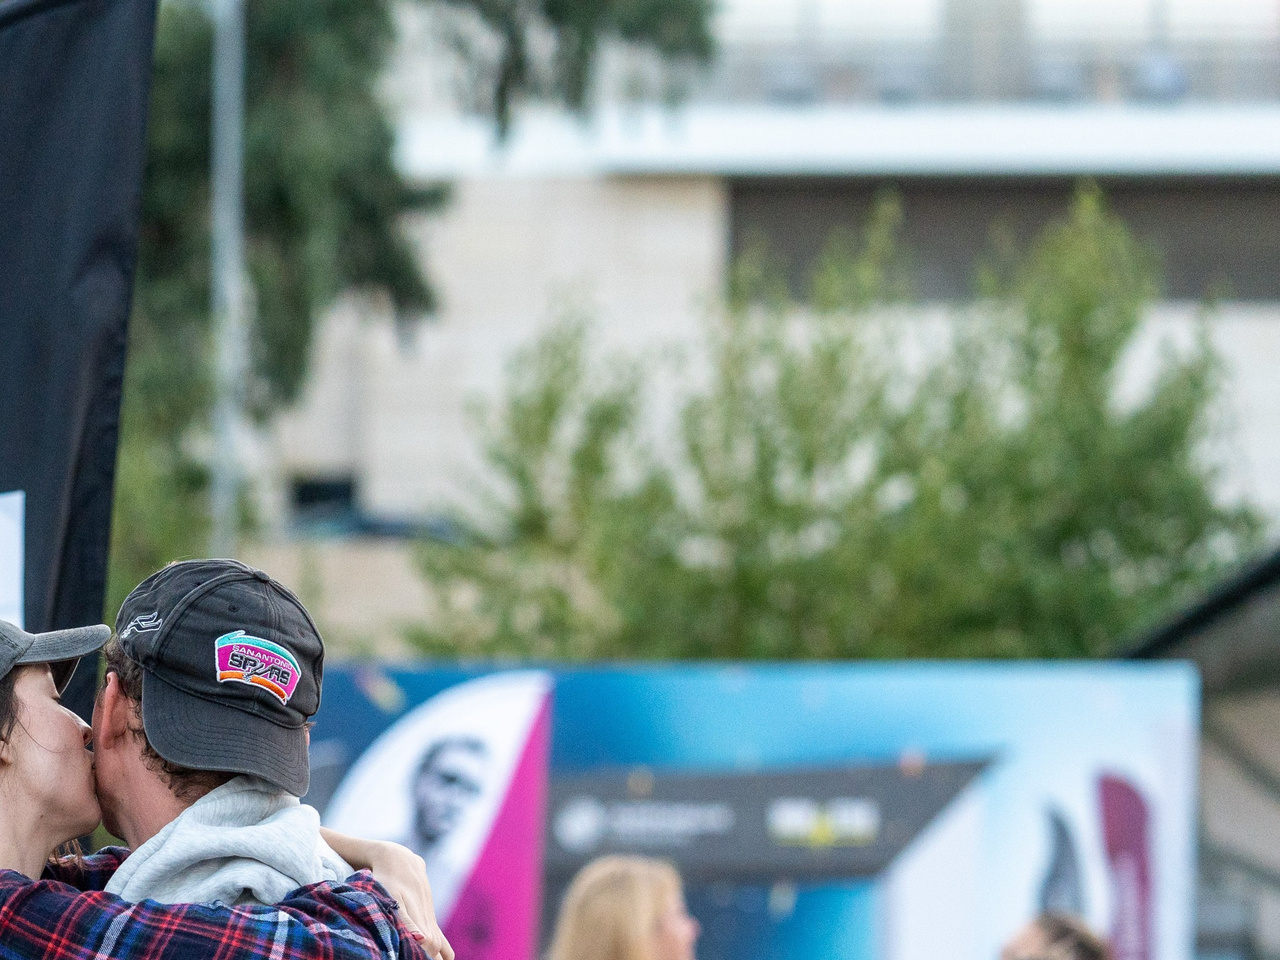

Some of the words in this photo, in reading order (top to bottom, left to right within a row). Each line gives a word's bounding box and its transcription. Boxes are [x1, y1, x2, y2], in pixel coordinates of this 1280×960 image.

[229, 651, 291, 687] SPURS
[232, 644, 254, 657] SAN
[254, 653, 293, 670] ANTONIO
